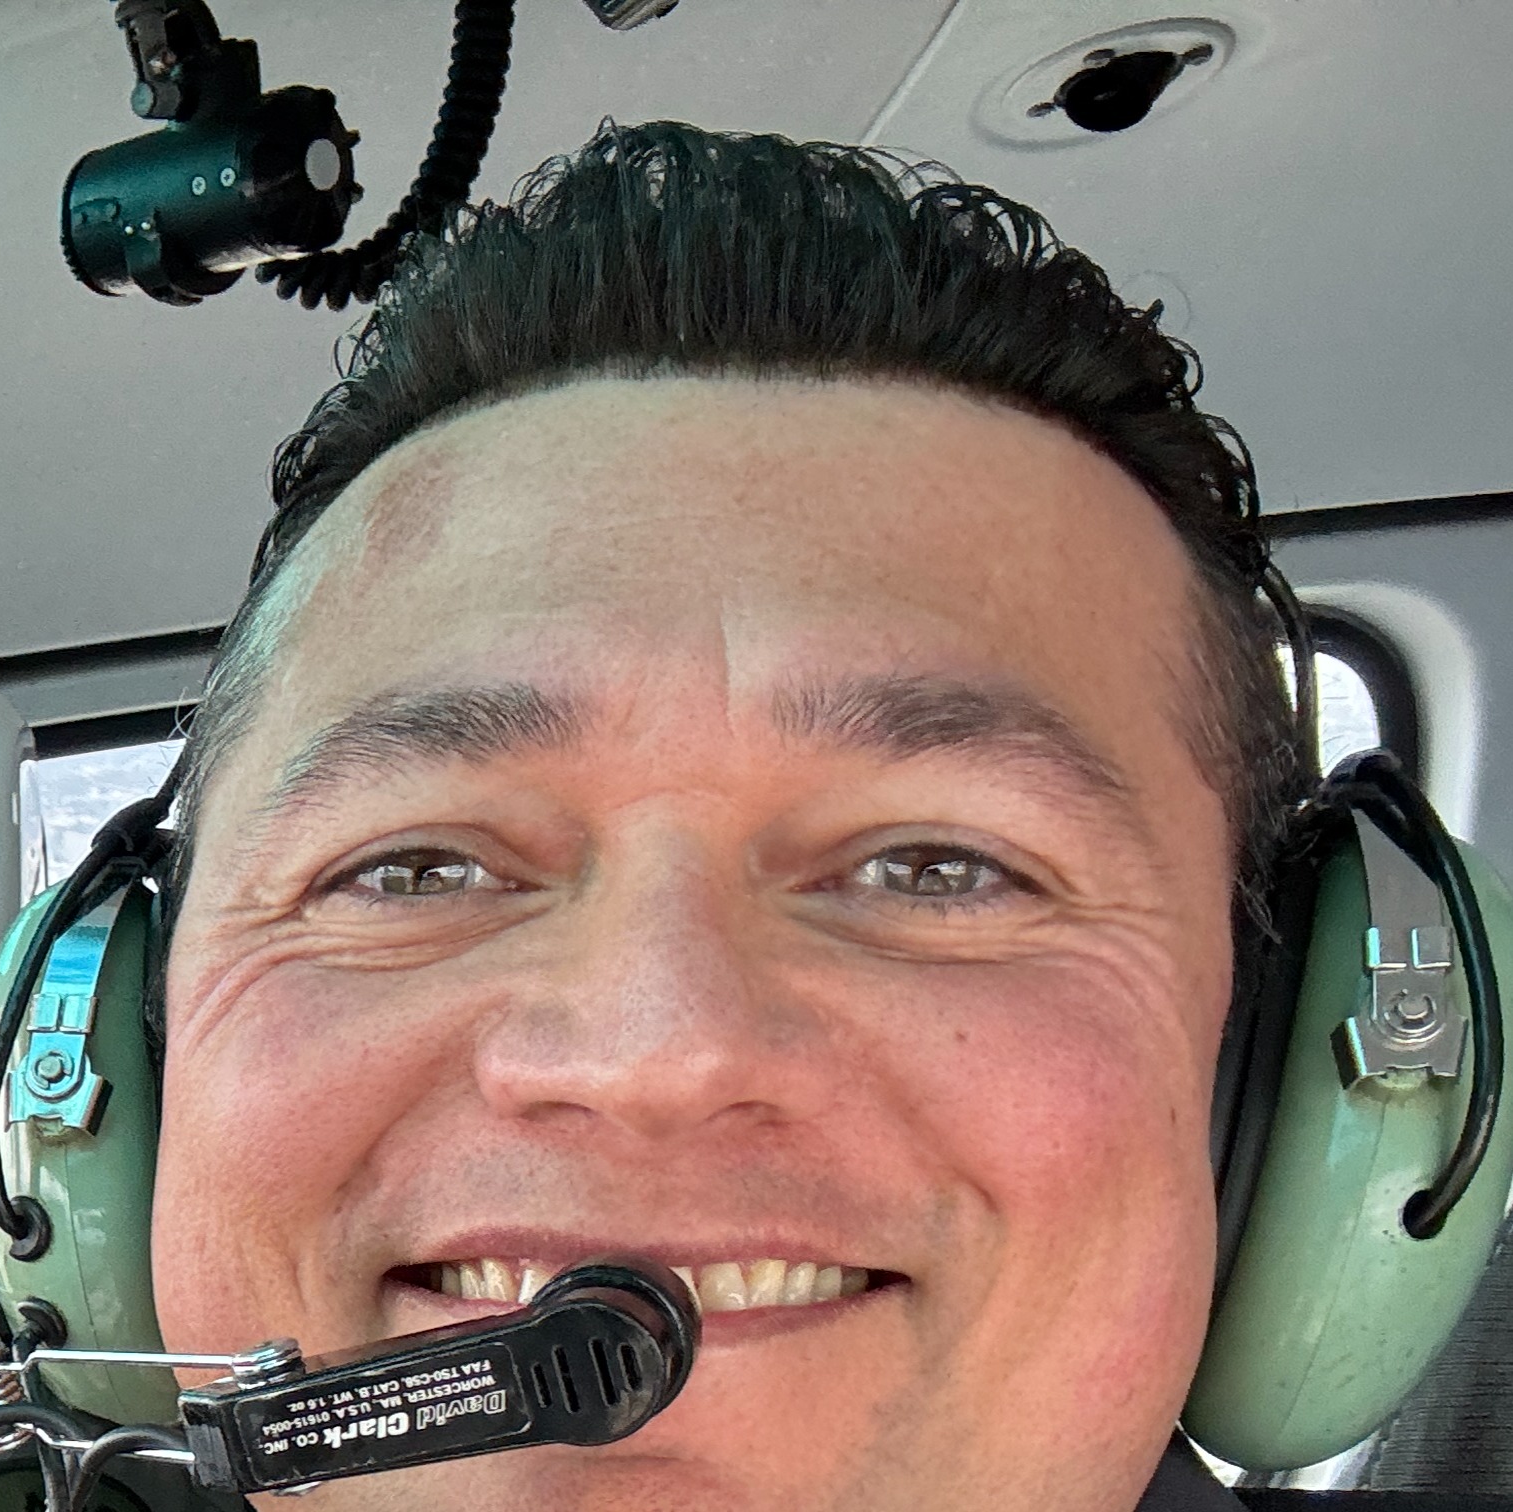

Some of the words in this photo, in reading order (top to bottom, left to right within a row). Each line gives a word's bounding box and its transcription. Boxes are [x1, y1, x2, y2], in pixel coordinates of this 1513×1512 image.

[461, 1359, 492, 1377] FAA
[416, 1389, 507, 1431] David
[291, 1430, 319, 1448] CO.
[323, 1412, 410, 1449] Clark
[258, 1439, 290, 1455] INC.
